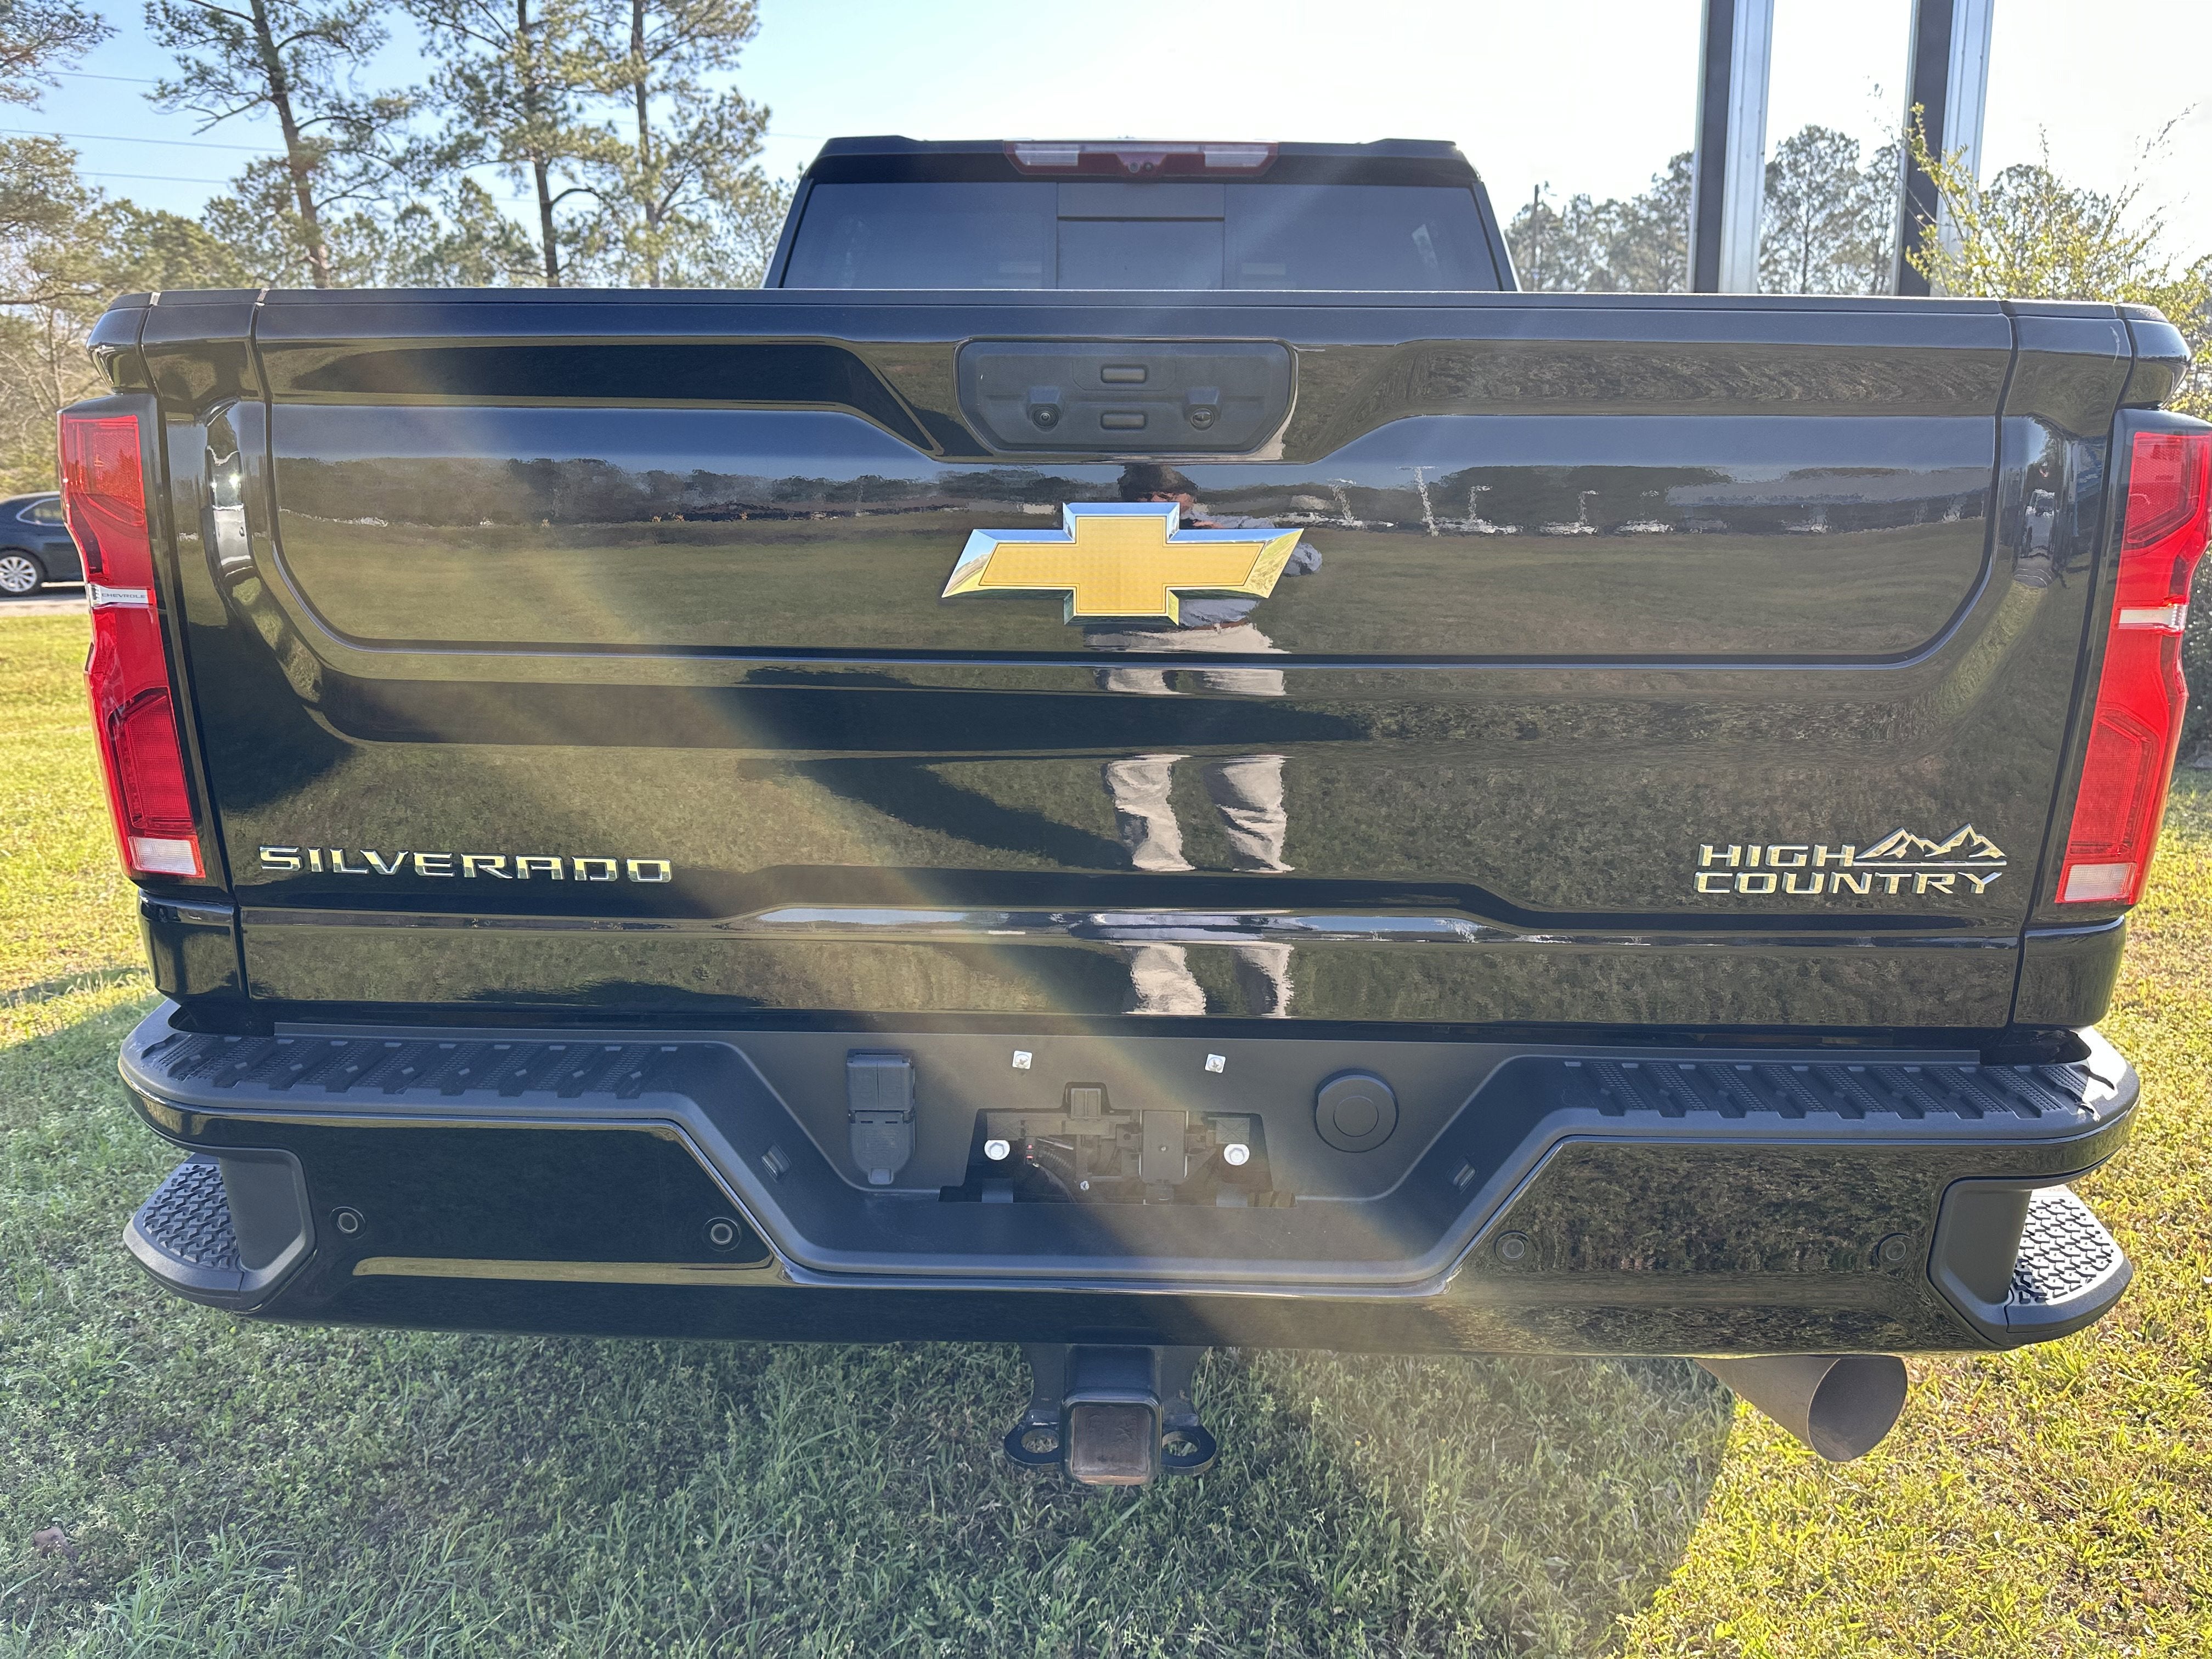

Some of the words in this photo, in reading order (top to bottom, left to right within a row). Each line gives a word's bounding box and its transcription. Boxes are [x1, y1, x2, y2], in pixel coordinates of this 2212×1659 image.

[258, 846, 673, 883] SILVERADO
[1698, 843, 1855, 867] HIGH
[1694, 871, 2002, 894] COUNTRY
